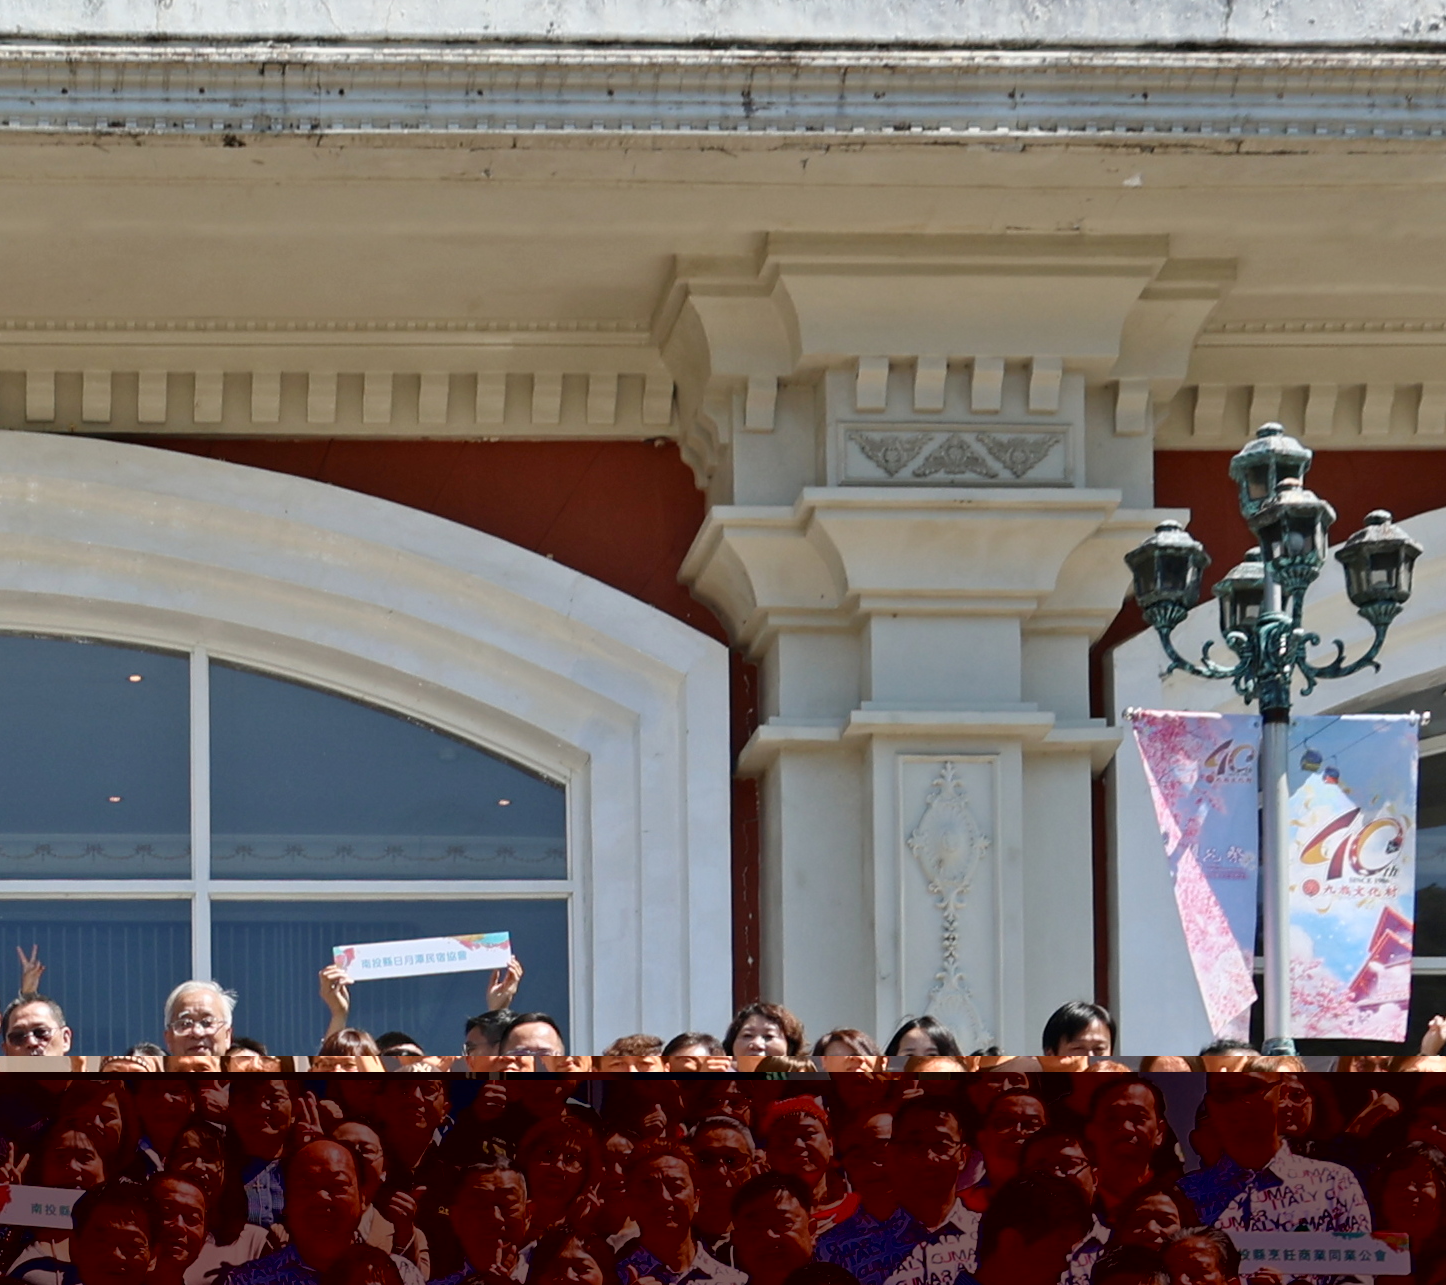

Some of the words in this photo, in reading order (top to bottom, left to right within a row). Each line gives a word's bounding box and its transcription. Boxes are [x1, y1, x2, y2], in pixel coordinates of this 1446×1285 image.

[361, 950, 467, 969] 南投縣日月潭民宿協會
